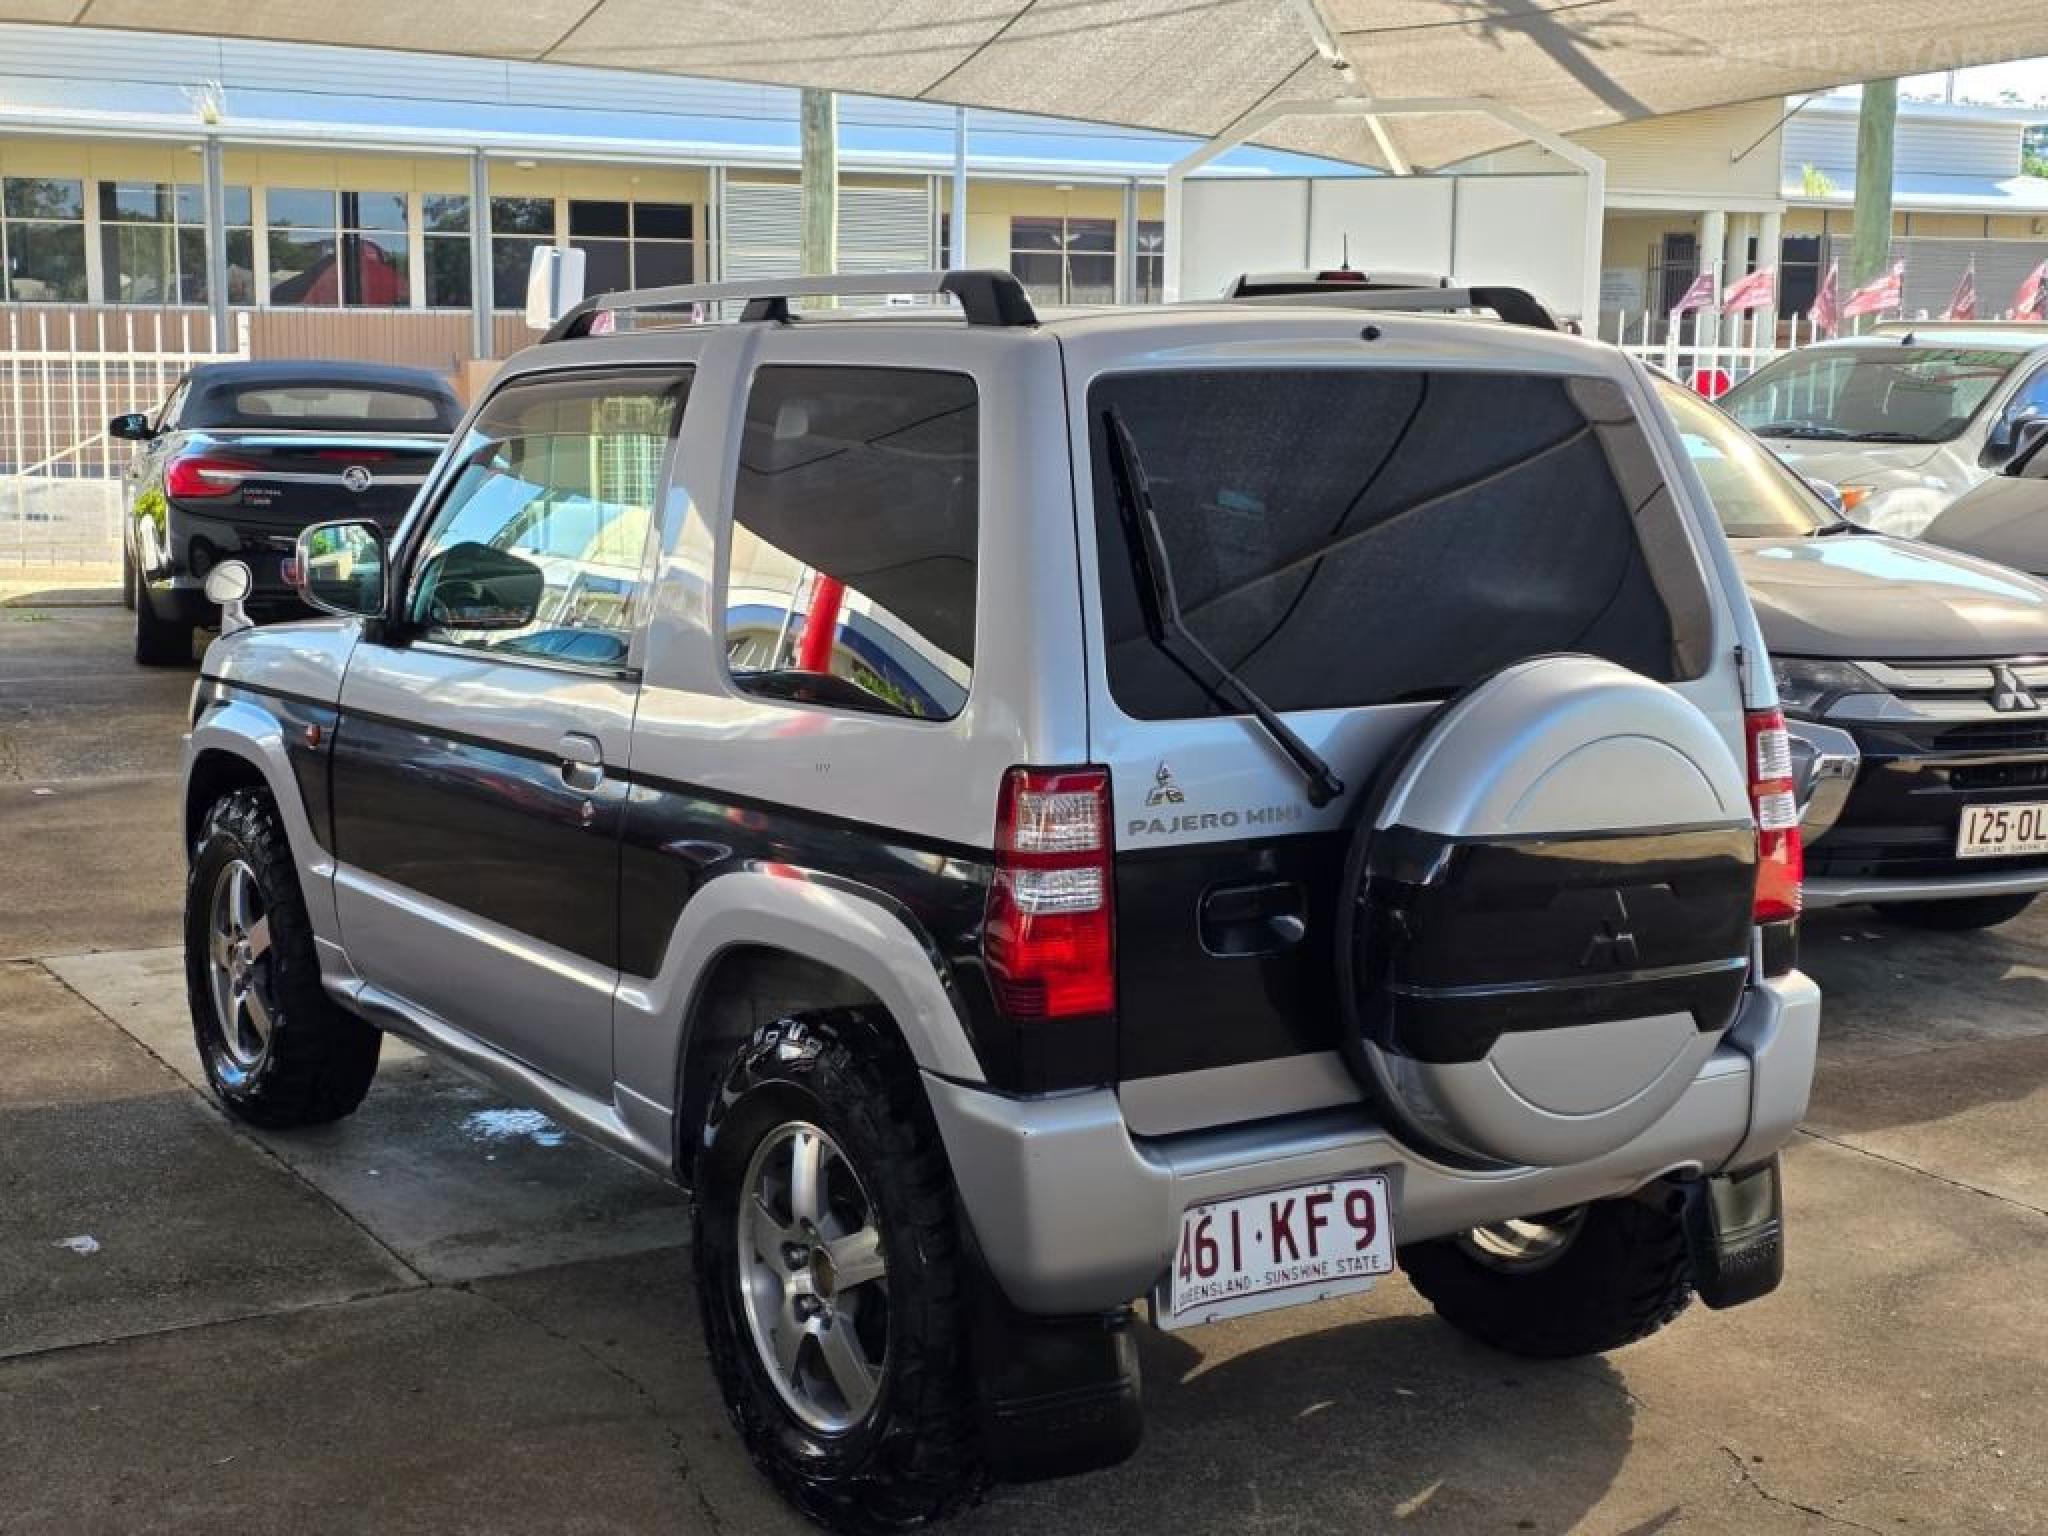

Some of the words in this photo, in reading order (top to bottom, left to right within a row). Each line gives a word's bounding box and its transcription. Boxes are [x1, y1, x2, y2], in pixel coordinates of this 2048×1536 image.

[1128, 811, 1238, 836] PAJERO
[1247, 805, 1303, 825] MINI
[1265, 1261, 1329, 1285] SUNSHINE
[1336, 1254, 1380, 1272] STATE
